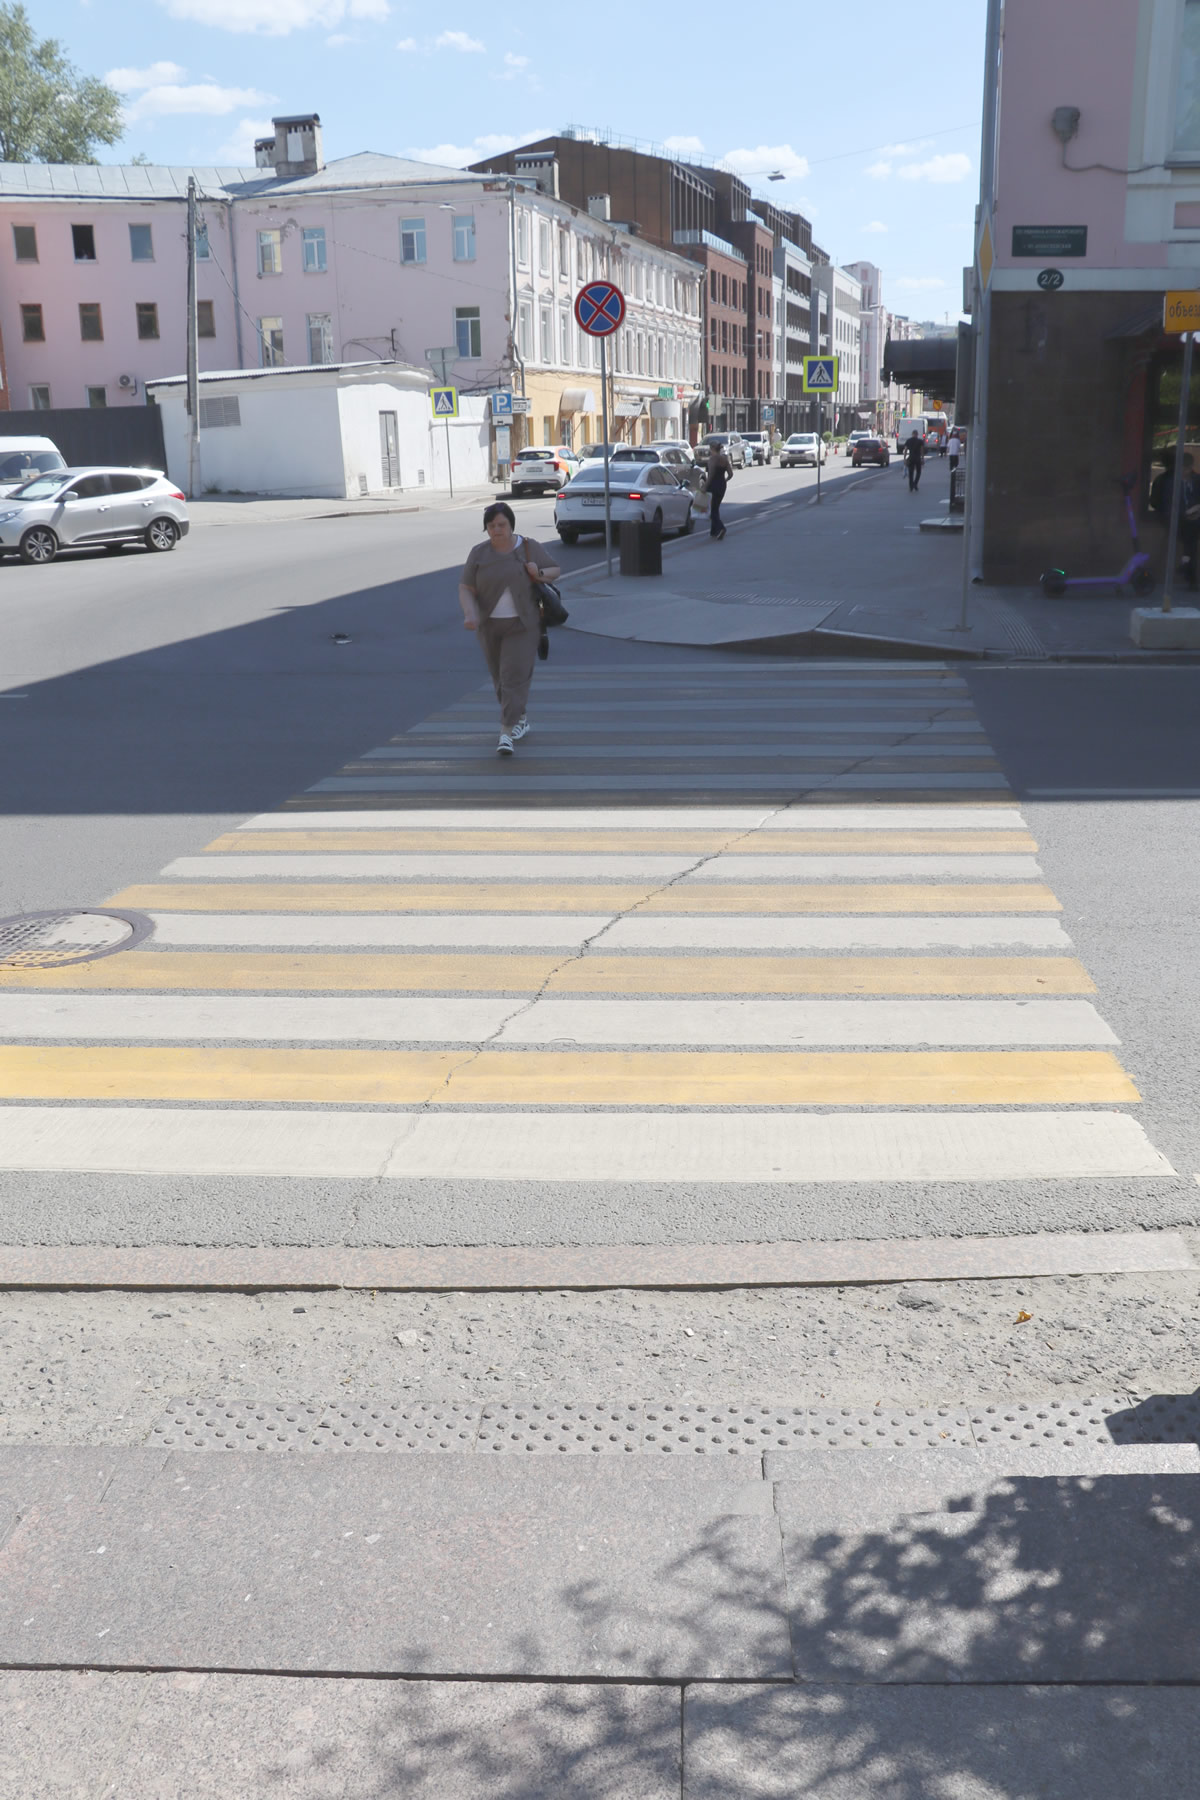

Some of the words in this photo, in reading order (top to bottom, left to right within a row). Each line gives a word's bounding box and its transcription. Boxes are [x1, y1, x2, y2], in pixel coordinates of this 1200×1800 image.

[1041, 273, 1060, 285] 2/2
[1169, 301, 1200, 317] объез
[496, 395, 508, 413] P
